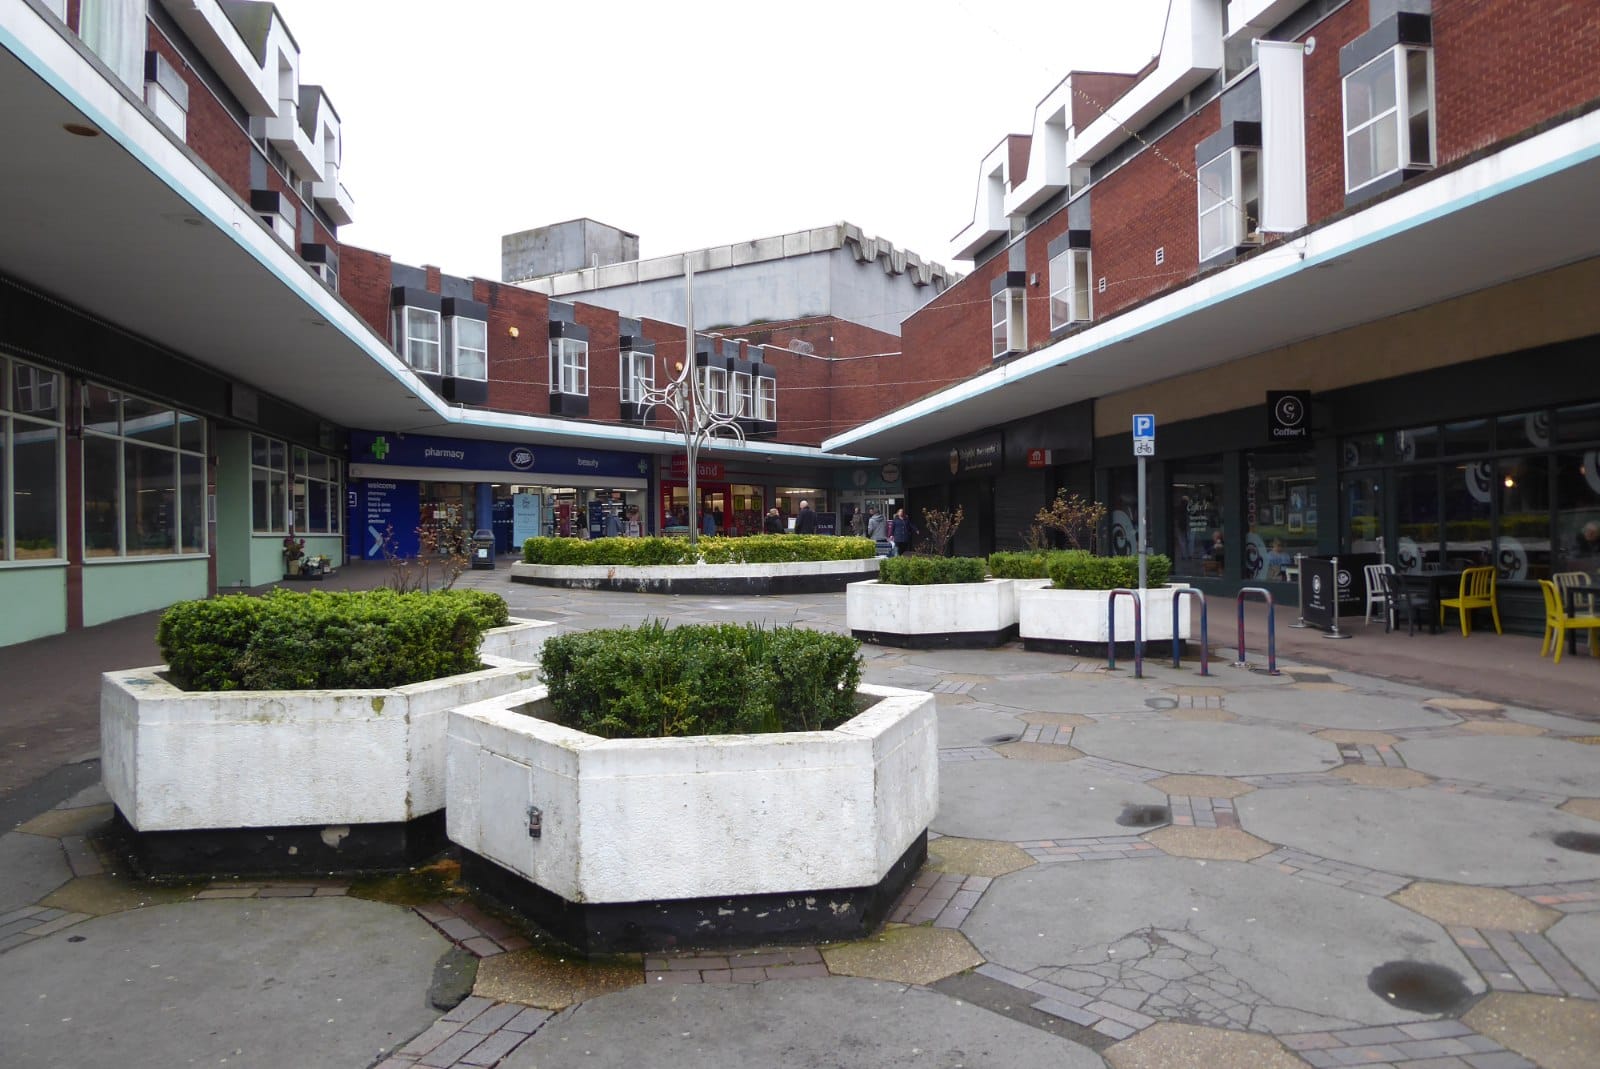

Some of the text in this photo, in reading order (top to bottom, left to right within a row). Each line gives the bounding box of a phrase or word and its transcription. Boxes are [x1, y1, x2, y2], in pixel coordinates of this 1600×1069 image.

[1137, 417, 1150, 435] P
[424, 447, 465, 460] pharmacy
[577, 457, 599, 469] beauty
[367, 481, 396, 489] welcome
